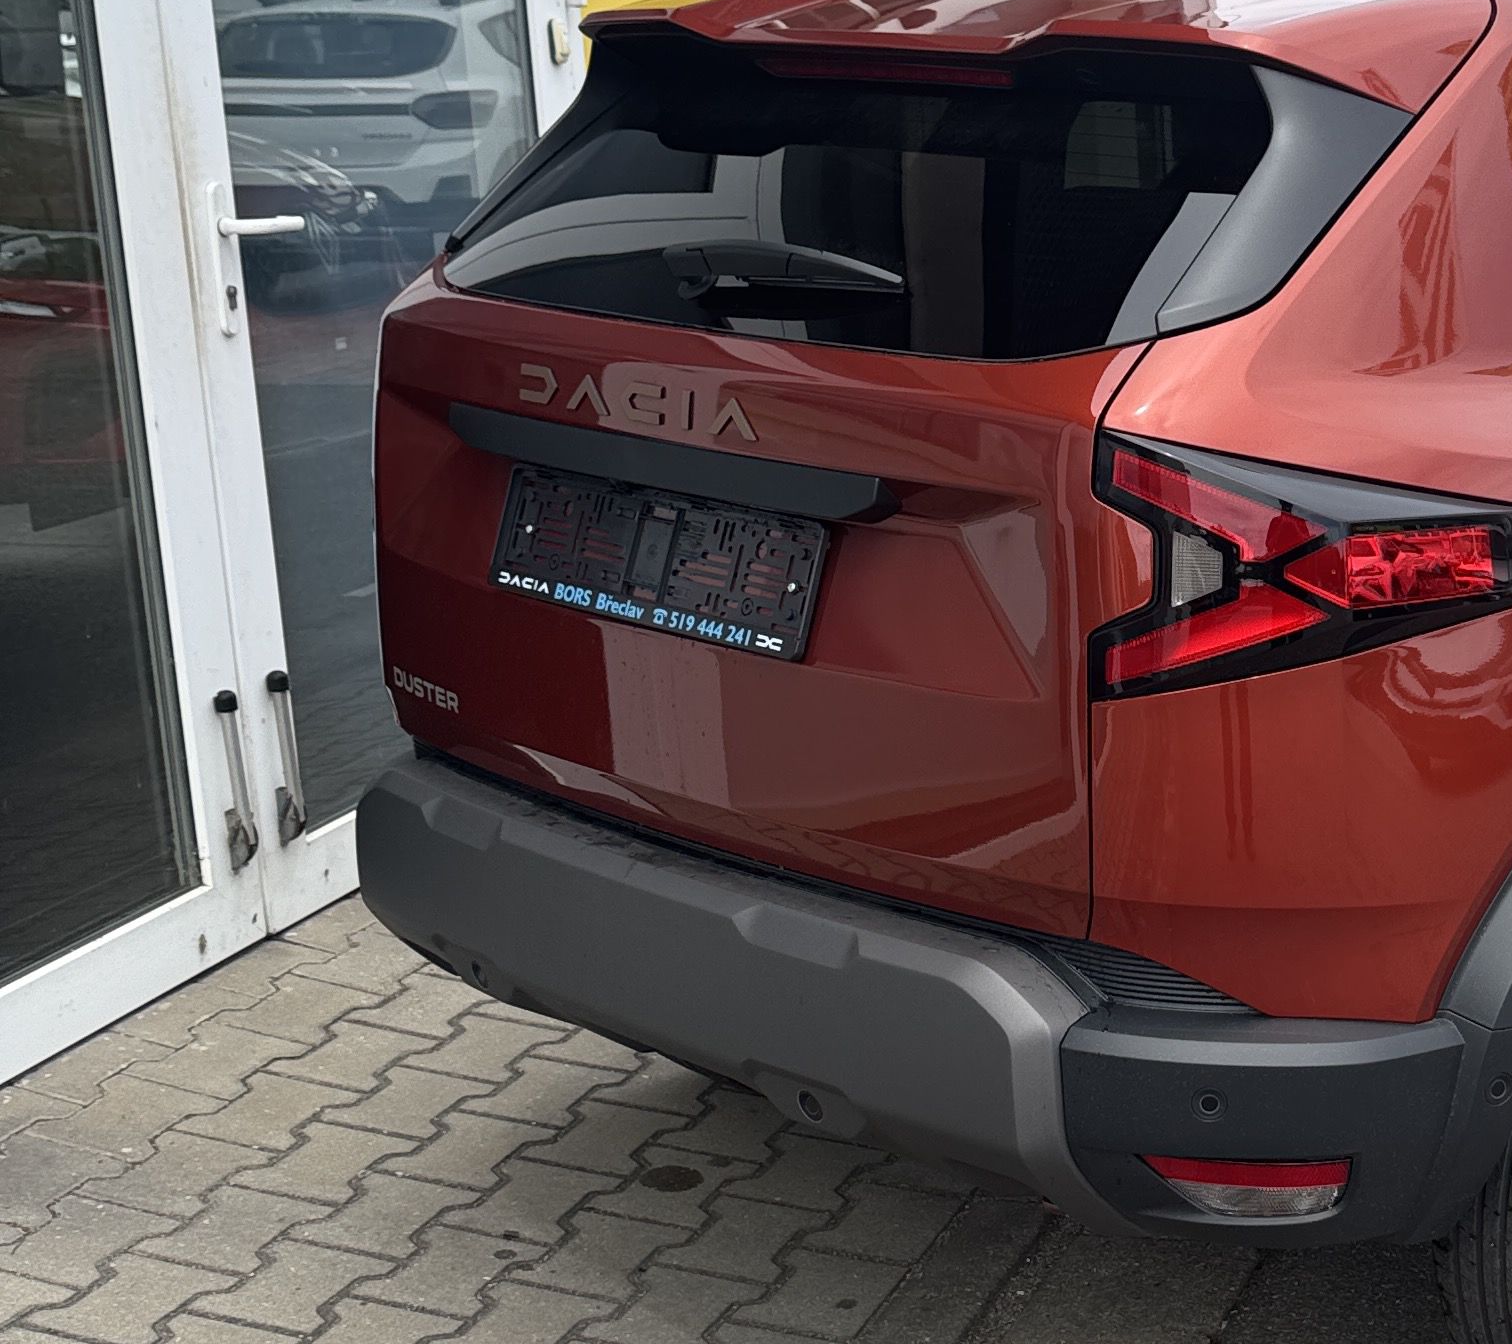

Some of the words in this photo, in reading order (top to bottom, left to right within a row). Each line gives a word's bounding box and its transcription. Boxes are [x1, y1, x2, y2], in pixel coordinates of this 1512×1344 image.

[519, 363, 760, 442] DACIA
[498, 571, 549, 594] DACIA
[554, 582, 592, 606] BORS
[596, 592, 645, 620] Břeclav
[668, 611, 695, 631] 519
[697, 618, 722, 639] 444
[725, 625, 752, 646] 241
[393, 666, 459, 714] DUSTER
